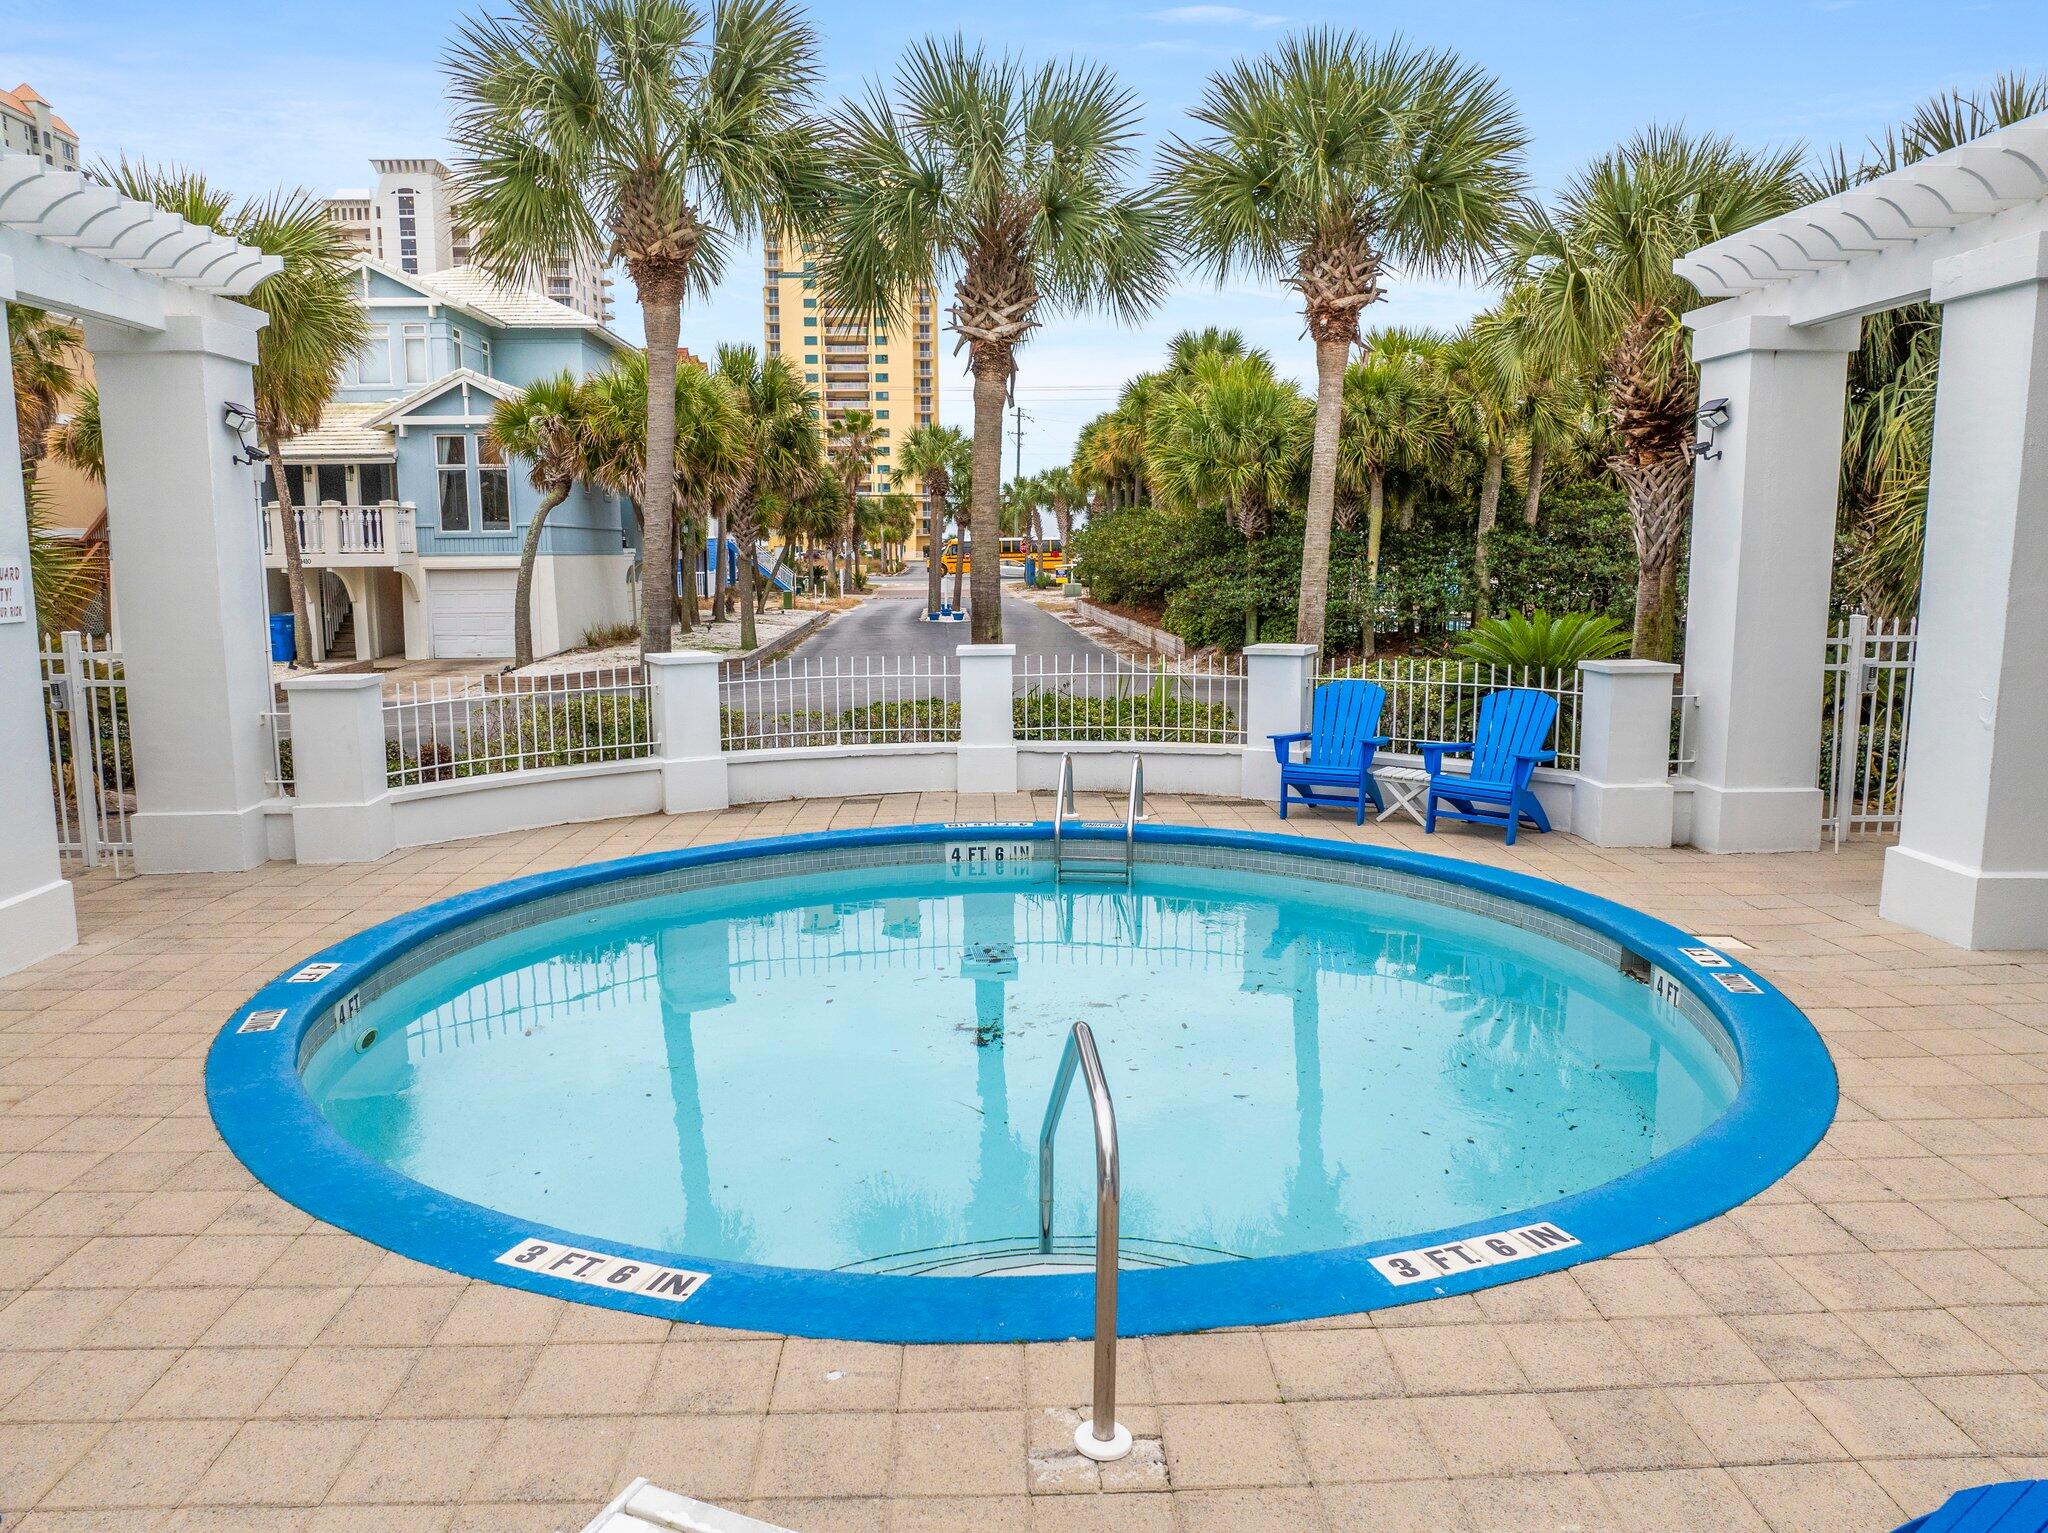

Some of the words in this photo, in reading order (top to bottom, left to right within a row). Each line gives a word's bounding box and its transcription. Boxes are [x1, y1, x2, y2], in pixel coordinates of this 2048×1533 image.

[951, 847, 961, 862] 4
[995, 846, 1004, 861] 6
[1657, 975, 1664, 997] 4
[339, 1004, 345, 1025] 4
[1388, 1258, 1421, 1278] 3
[1424, 1245, 1482, 1270] FT.
[1484, 1238, 1518, 1257] 6
[1518, 1226, 1576, 1249] IN.
[514, 1245, 549, 1264] 3
[548, 1252, 606, 1278] FT.
[606, 1265, 641, 1284] 6
[645, 1272, 698, 1297] IN.
